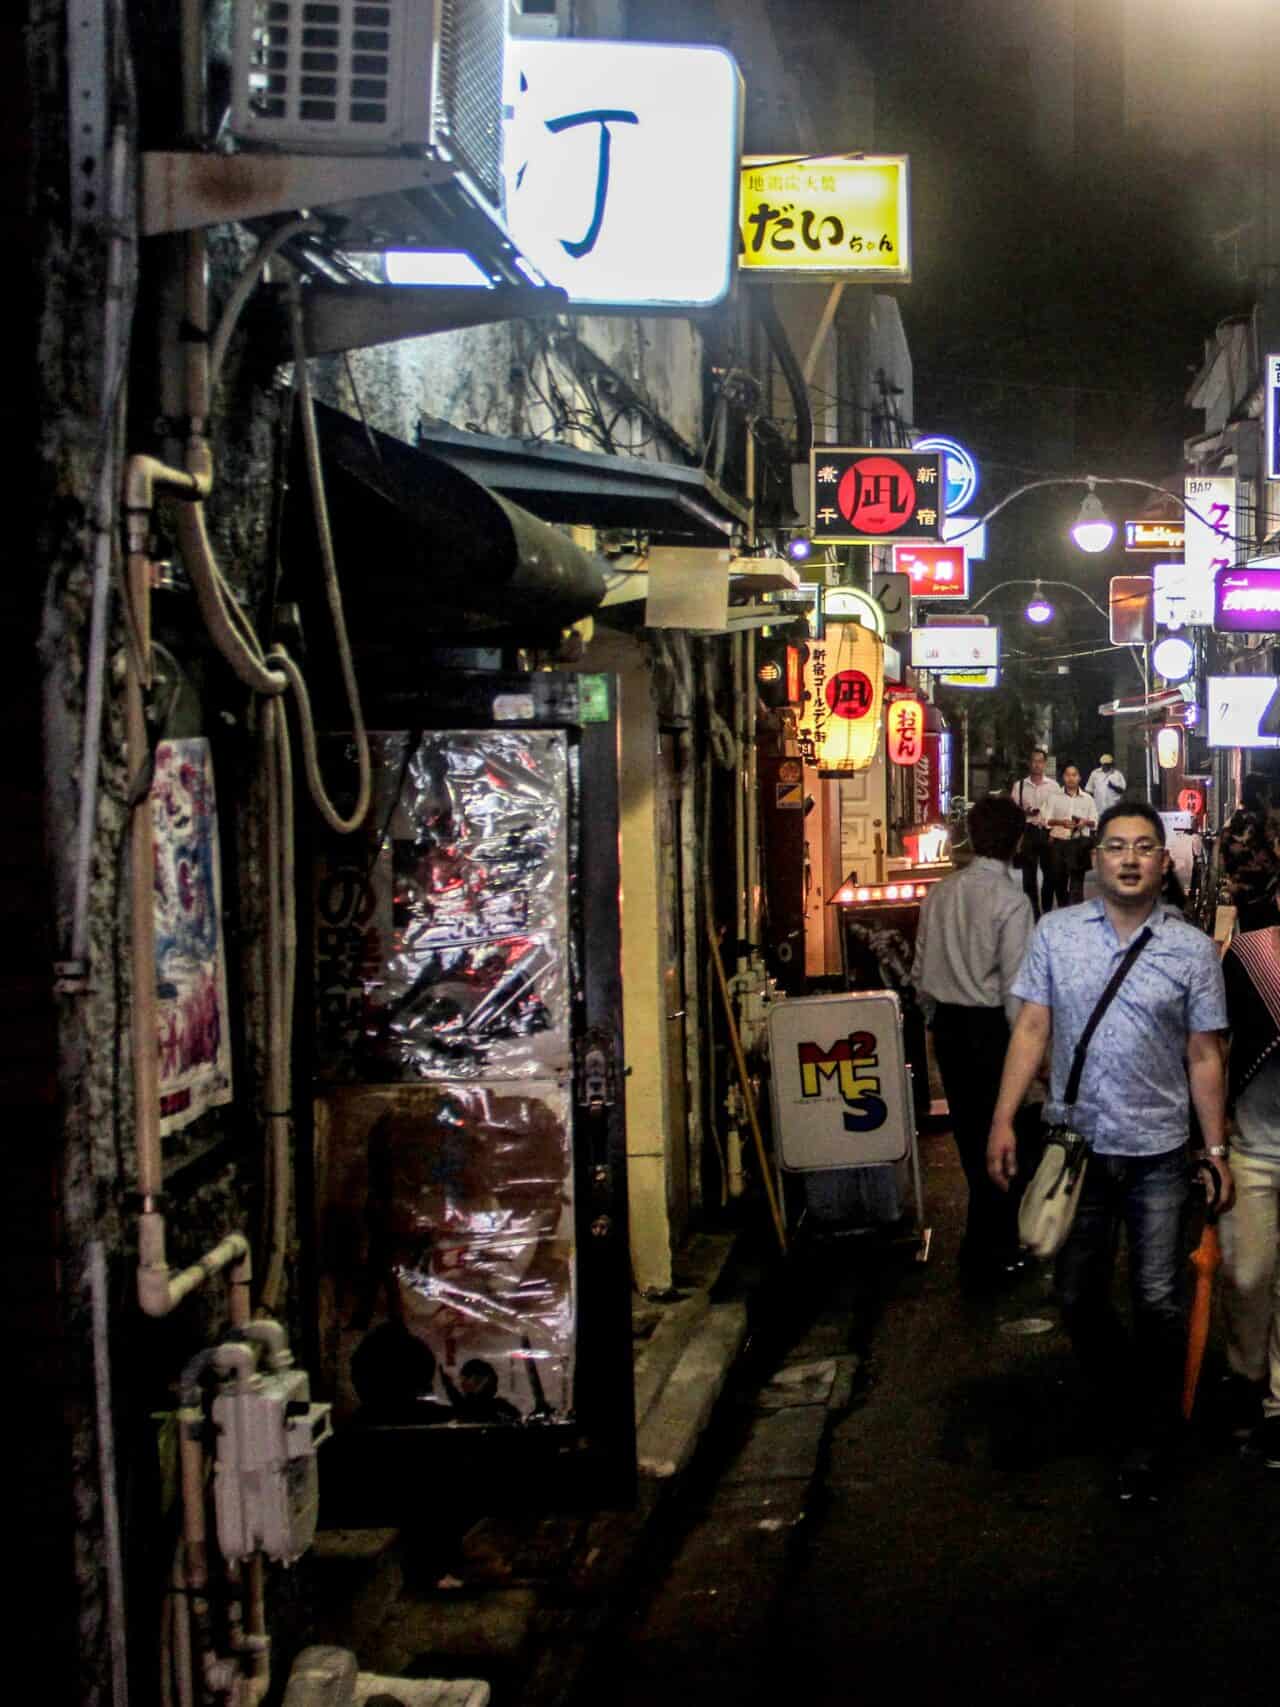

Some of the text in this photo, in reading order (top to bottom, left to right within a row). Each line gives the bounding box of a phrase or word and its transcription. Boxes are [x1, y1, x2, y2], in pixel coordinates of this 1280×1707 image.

[516, 95, 640, 260] 丁
[848, 465, 909, 522] 凪
[915, 466, 937, 526] 新宿
[896, 708, 917, 757] おでん
